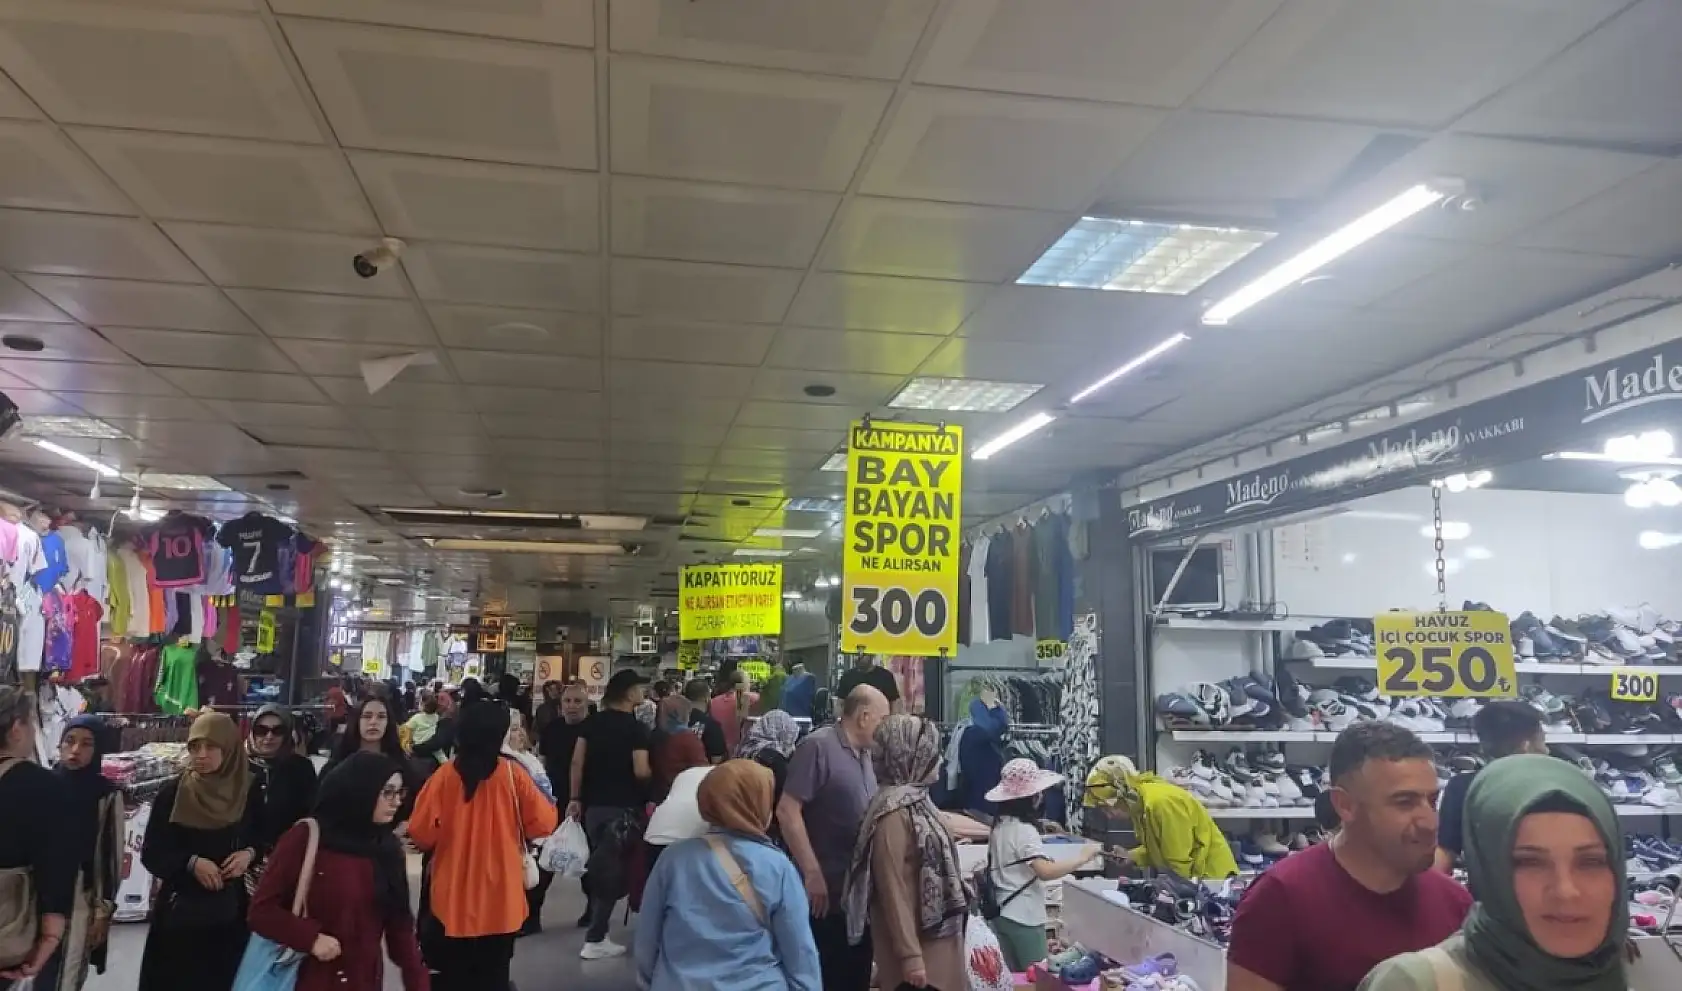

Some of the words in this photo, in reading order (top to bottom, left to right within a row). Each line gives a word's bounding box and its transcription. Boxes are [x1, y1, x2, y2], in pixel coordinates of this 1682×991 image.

[856, 429, 955, 453] KAMPANYA
[857, 456, 952, 488] BAY
[1227, 474, 1289, 505] Madeno
[853, 487, 955, 520] BAYAN
[160, 535, 192, 559] 10
[853, 520, 951, 556] SPOR
[243, 541, 261, 573] 7
[861, 556, 880, 569] NE
[883, 557, 941, 572] ALIRSAN
[685, 570, 777, 588] KAPATIYORUZ
[849, 586, 948, 637] 300
[1415, 616, 1470, 627] HAVUZ
[1380, 630, 1400, 644] İÇİ
[1405, 631, 1459, 645] ÇOCUK
[1464, 631, 1505, 643] SPOR
[1036, 643, 1062, 659] 350
[1616, 674, 1654, 698] 300
